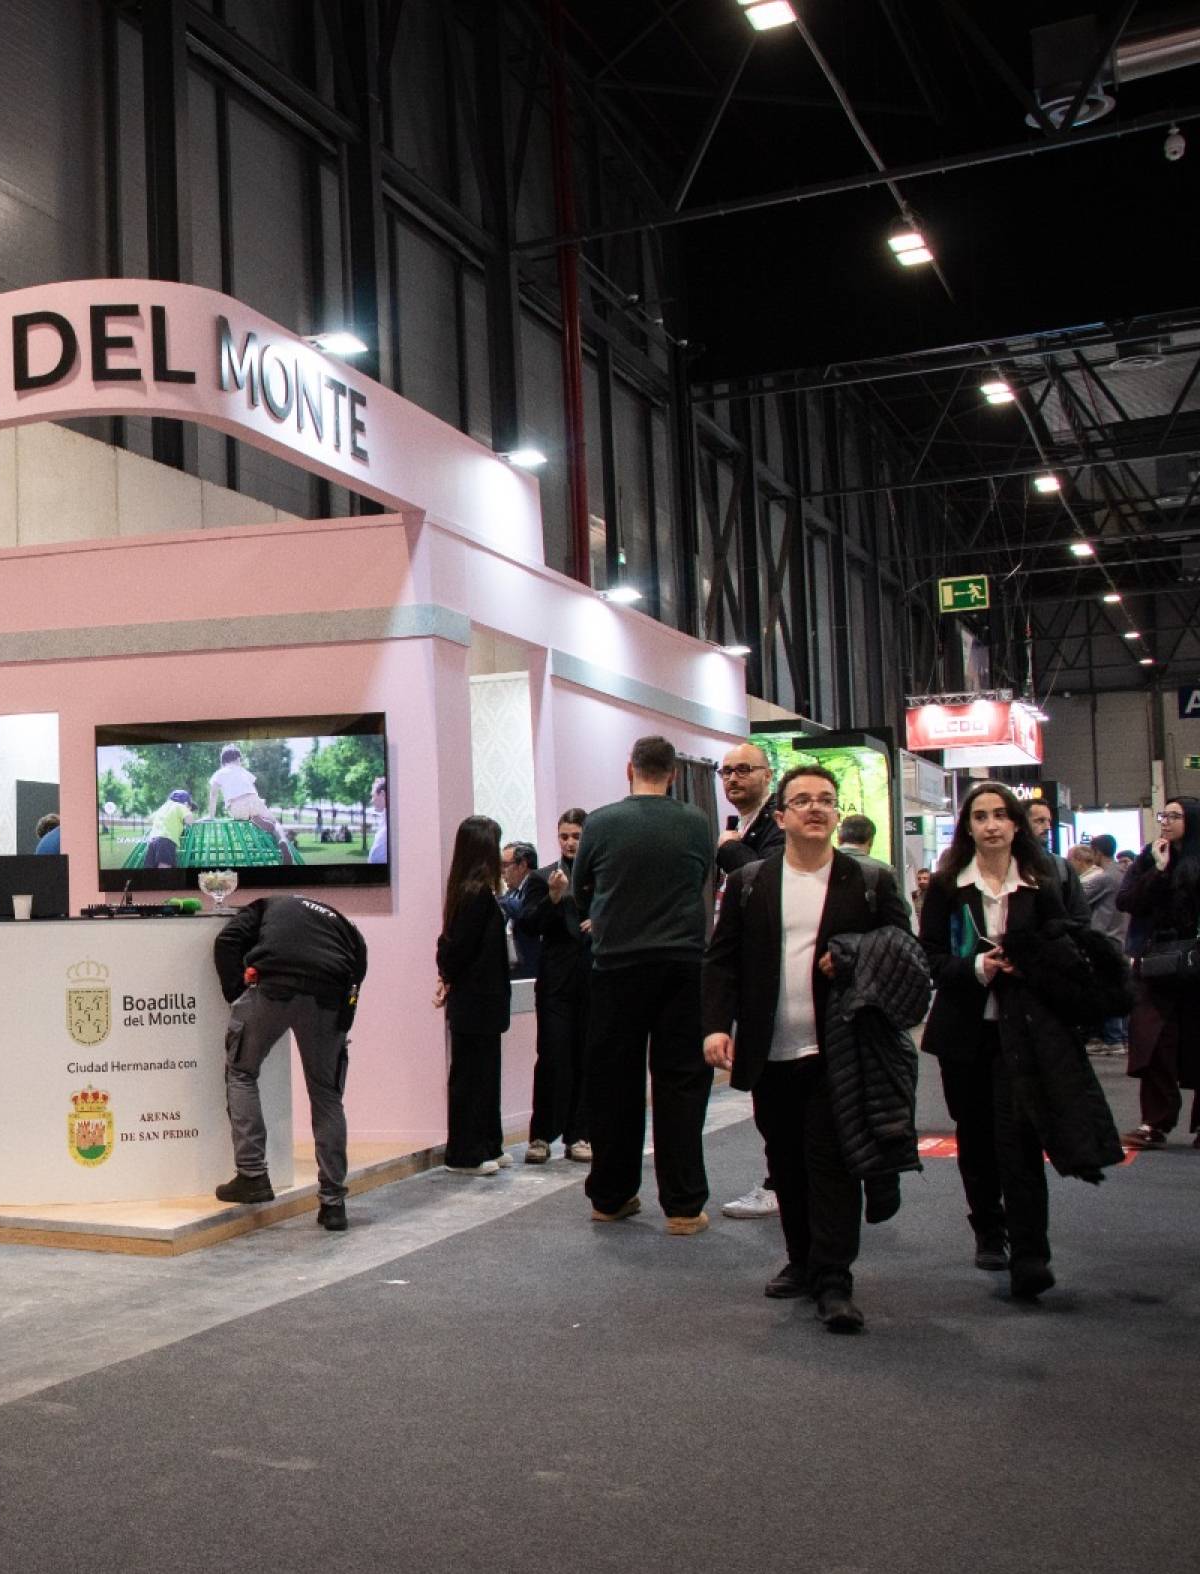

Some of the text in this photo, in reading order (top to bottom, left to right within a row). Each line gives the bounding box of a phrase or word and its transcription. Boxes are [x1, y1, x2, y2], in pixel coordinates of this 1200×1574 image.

[13, 303, 196, 392] DEL
[218, 314, 369, 463] MONTE
[123, 993, 196, 1012] Boadilla
[124, 1011, 196, 1027] del Monte
[67, 1058, 198, 1074] Ciudad Hermanada con
[139, 1111, 181, 1123] ARENAS
[120, 1128, 199, 1143] DE SAN PEDRO
